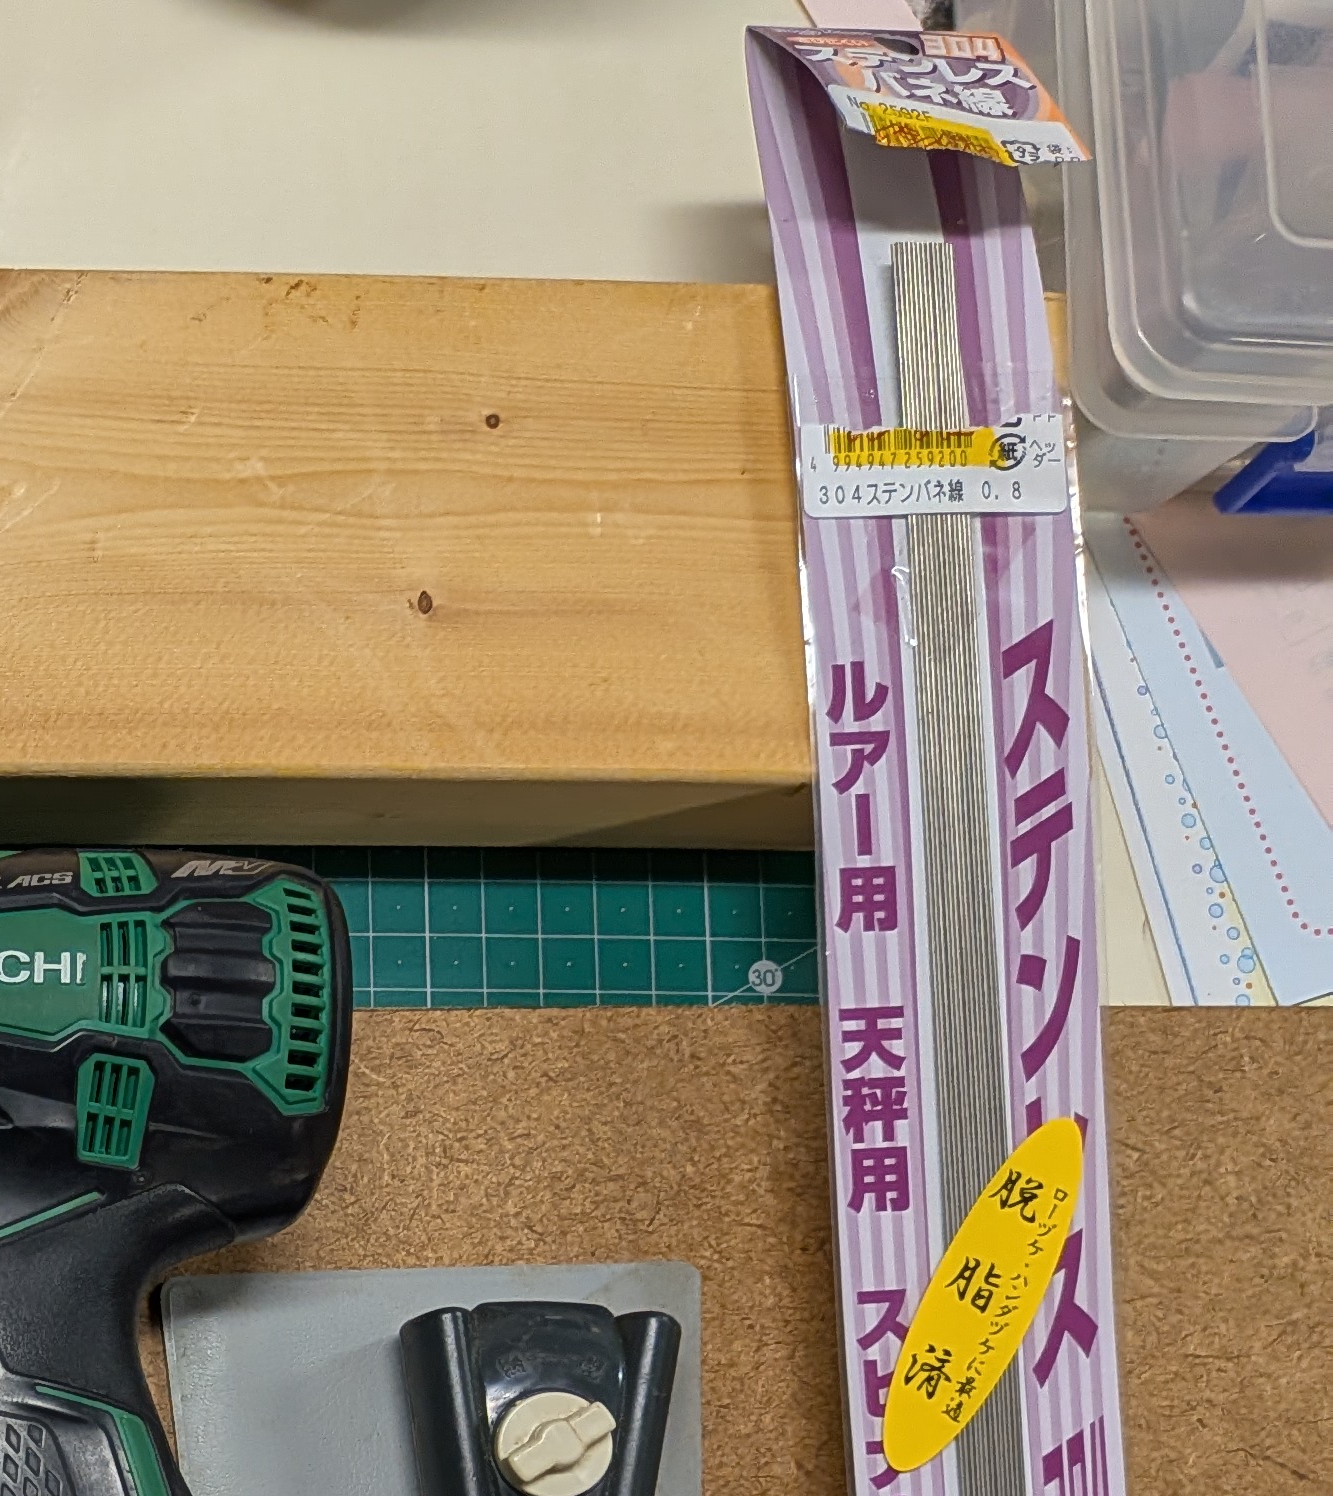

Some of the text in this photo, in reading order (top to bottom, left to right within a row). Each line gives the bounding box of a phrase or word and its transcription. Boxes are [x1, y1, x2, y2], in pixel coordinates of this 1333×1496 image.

[864, 69, 1017, 116] バネ線
[904, 451, 967, 469] 259200
[819, 480, 964, 505] 304ステンバネ線
[825, 660, 898, 932] ルアー用
[7, 871, 73, 889] ACS
[837, 1004, 912, 1214] 天秤用
